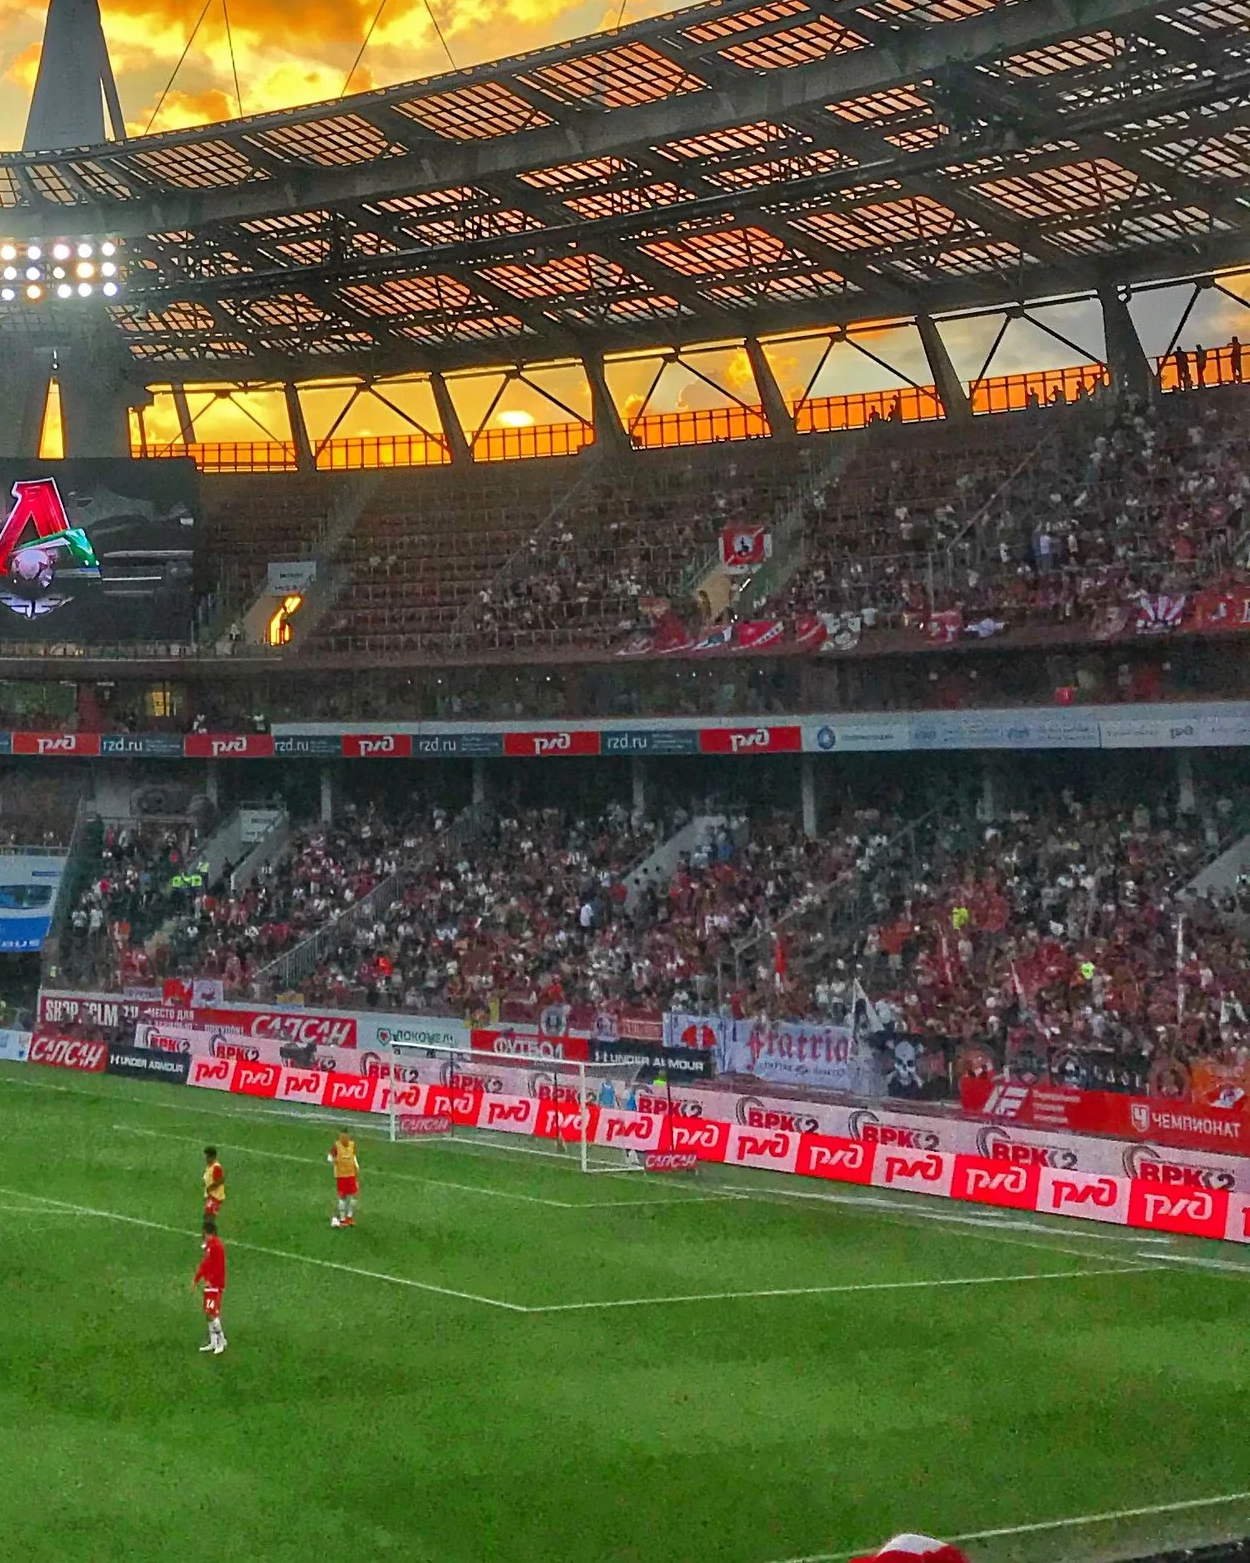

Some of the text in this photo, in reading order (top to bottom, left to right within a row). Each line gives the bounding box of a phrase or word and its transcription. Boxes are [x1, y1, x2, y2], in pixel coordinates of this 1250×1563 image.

[103, 738, 142, 751] rzd.ru
[274, 739, 309, 751] rzd.ru
[419, 738, 456, 751] rzd.ru
[607, 733, 647, 749] rzd.ru
[120, 1056, 185, 1073] UNDER ARMOUR
[609, 1053, 650, 1066] UNDER
[1151, 1112, 1241, 1138] ЧЕМПИОНАТ
